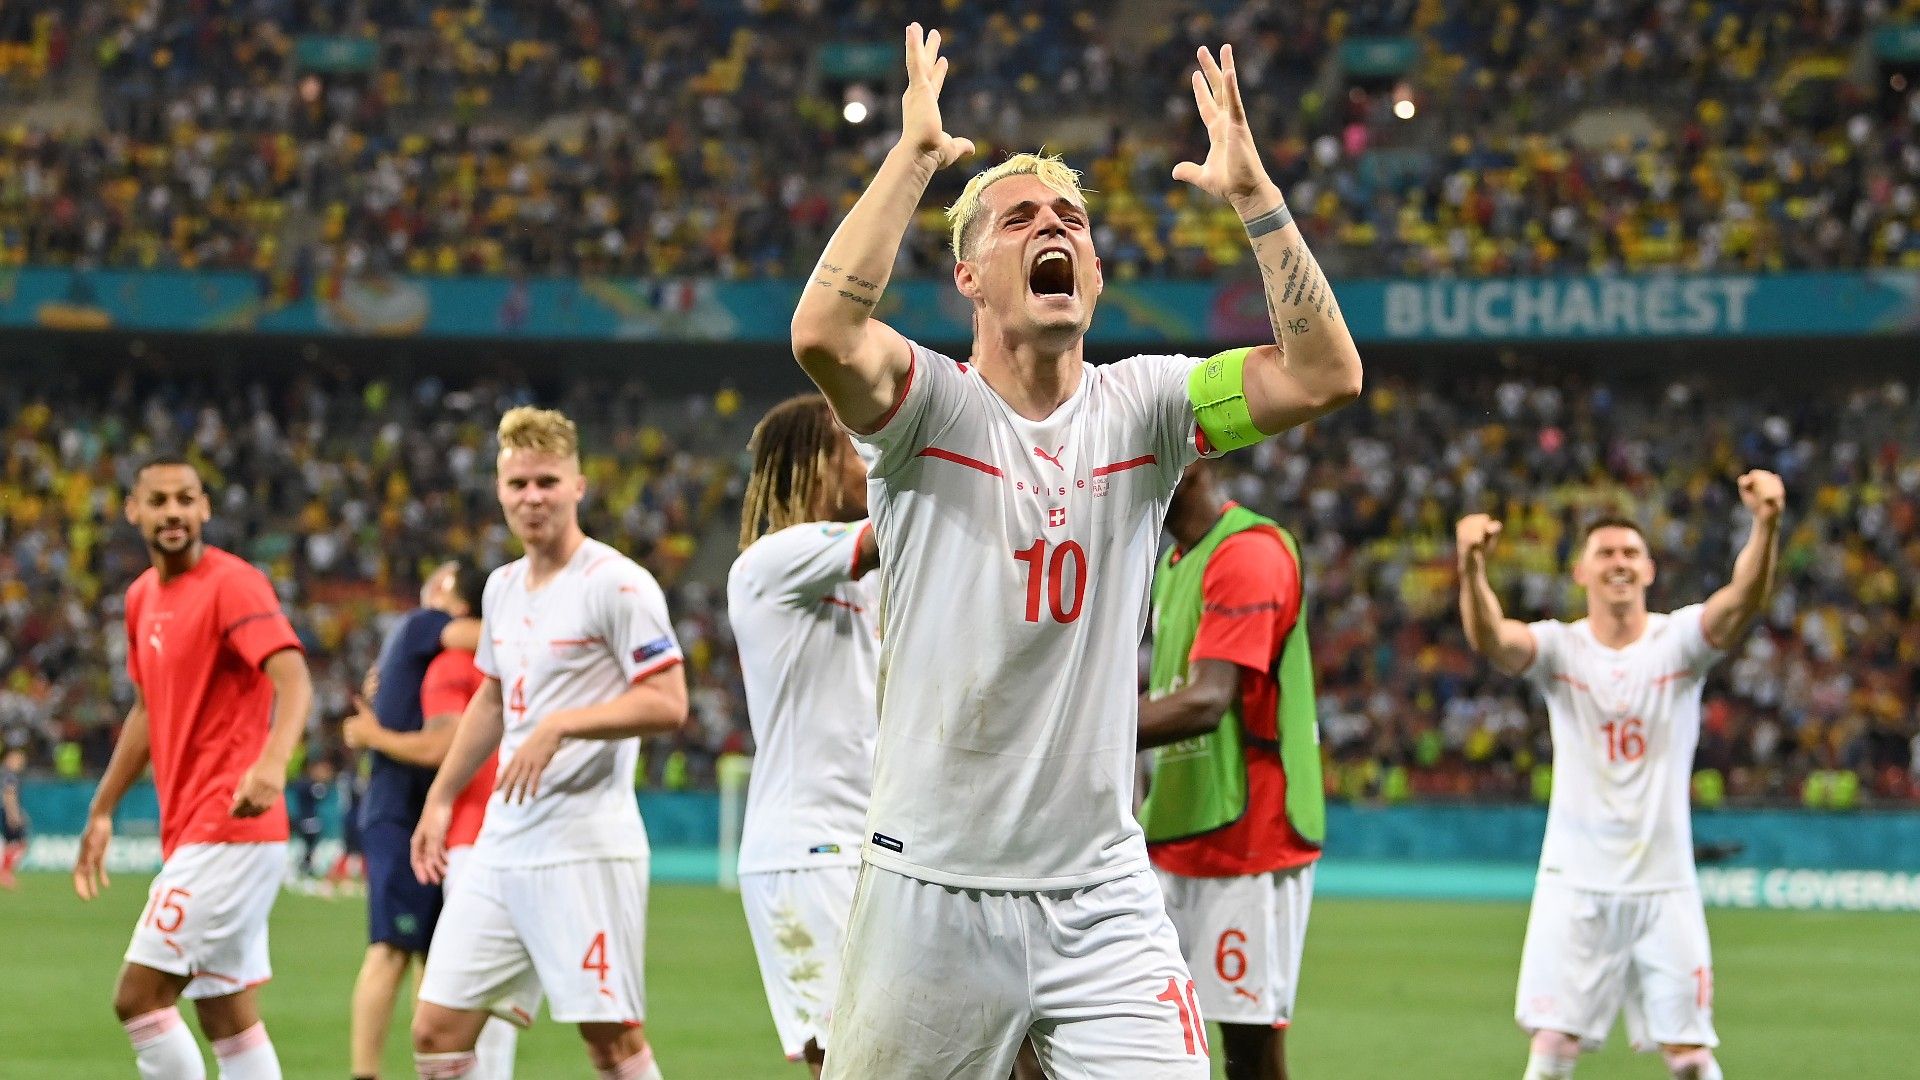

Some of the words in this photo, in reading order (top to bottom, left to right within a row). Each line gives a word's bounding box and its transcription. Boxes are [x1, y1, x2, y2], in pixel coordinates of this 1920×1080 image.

[1384, 278, 1755, 336] BUCHAREST
[1014, 539, 1087, 624] 10
[510, 675, 527, 720] 4
[1600, 717, 1646, 762] 16
[145, 887, 191, 933] 15
[1763, 868, 1920, 910] COVERA
[582, 931, 609, 982] 4
[1216, 928, 1247, 982] 6
[1690, 966, 1712, 1008] 1
